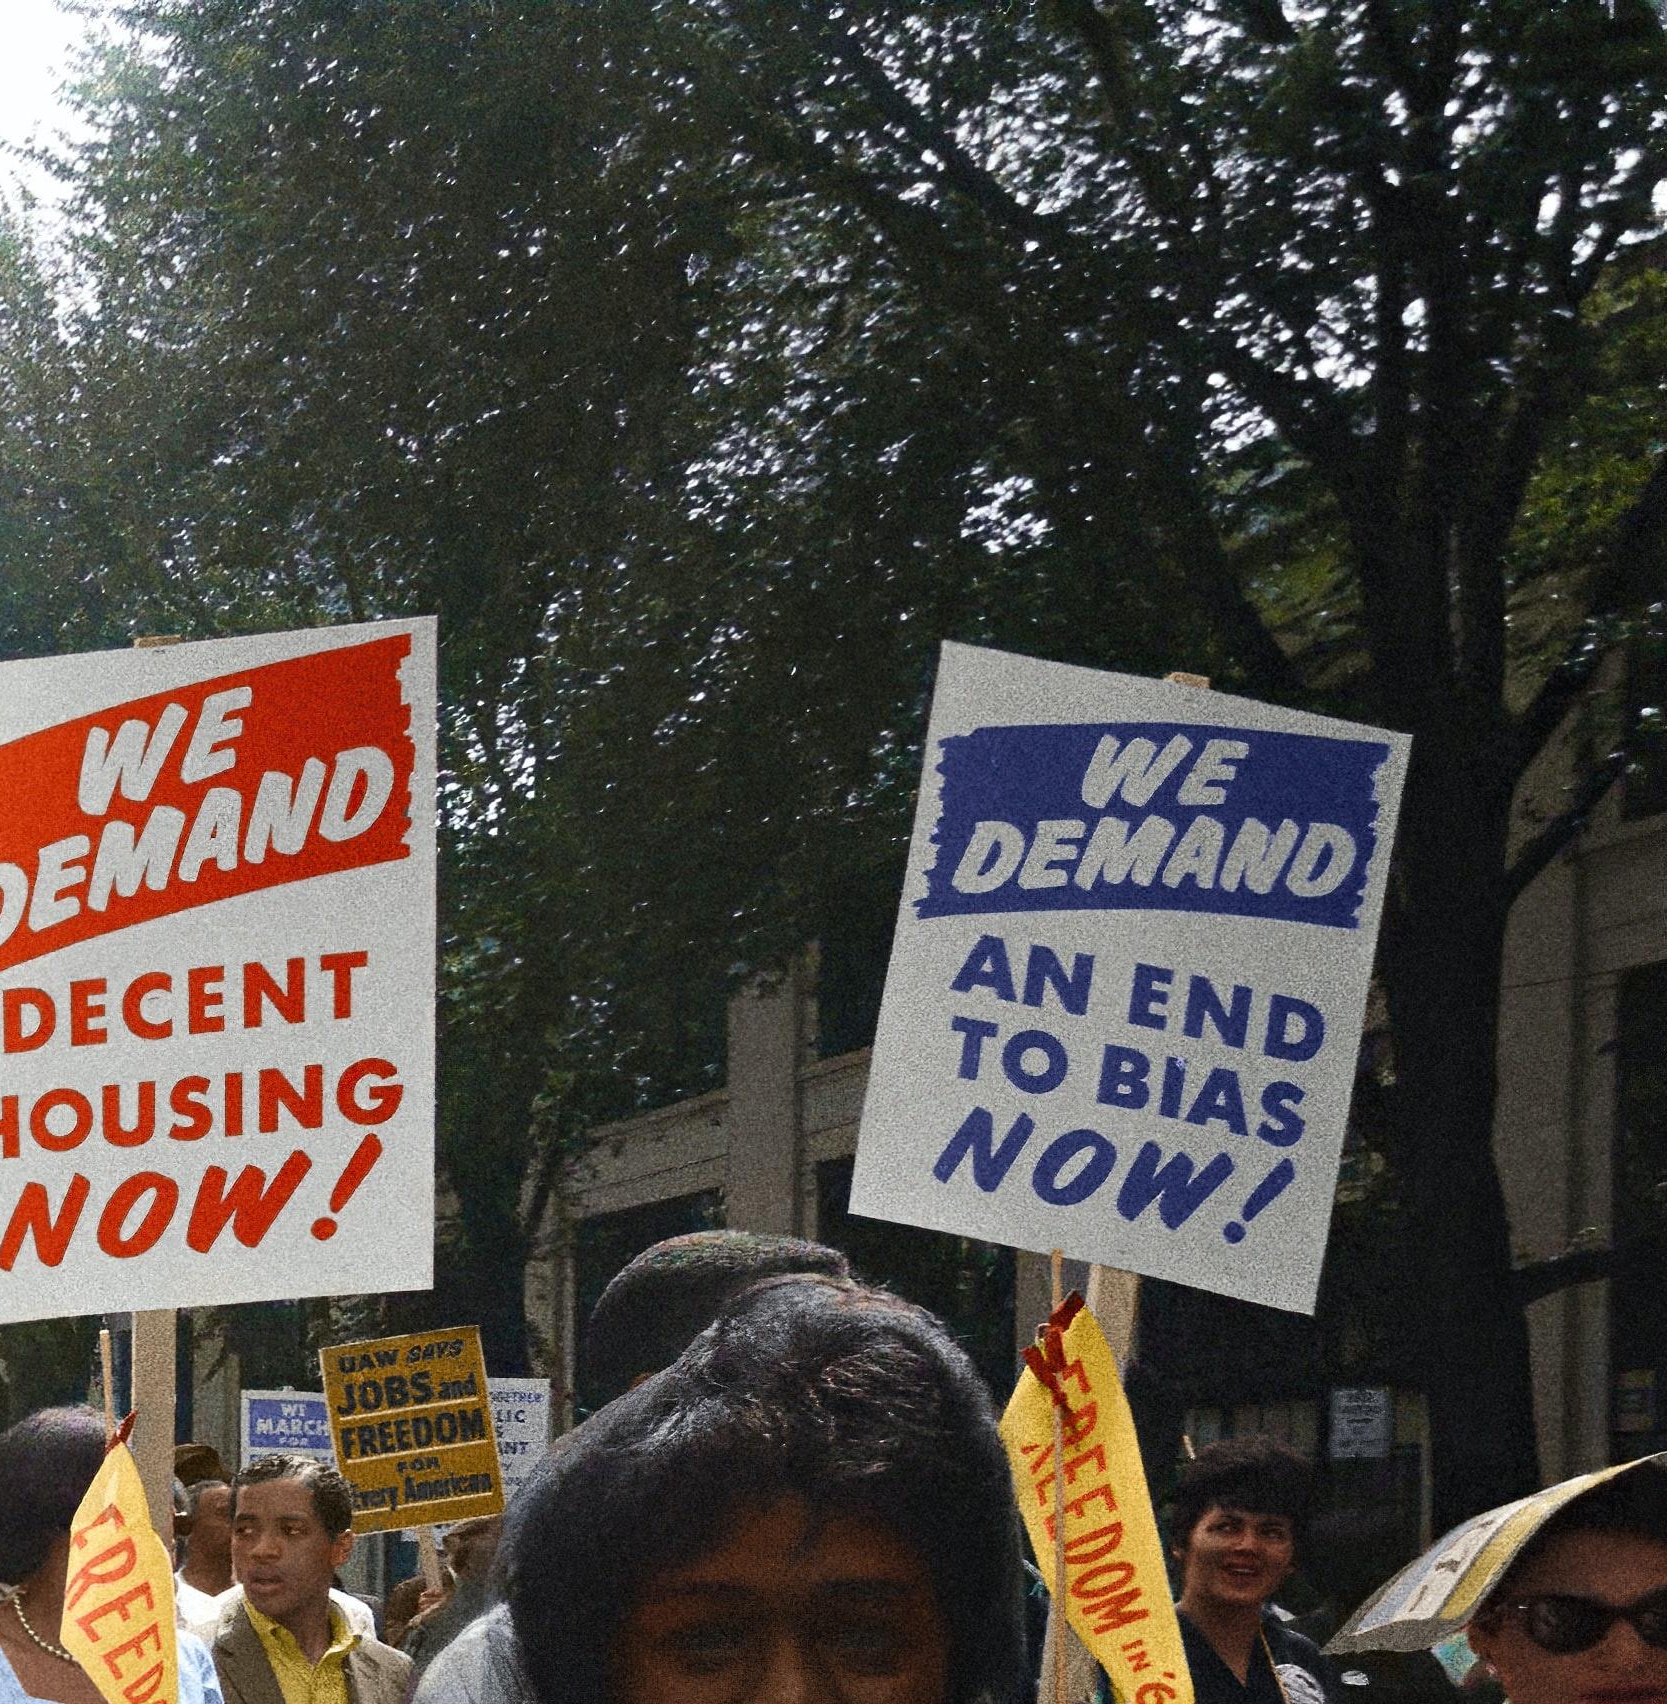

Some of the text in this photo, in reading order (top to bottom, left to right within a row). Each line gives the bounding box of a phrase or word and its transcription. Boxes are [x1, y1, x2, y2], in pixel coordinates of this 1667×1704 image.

[77, 686, 251, 816] WE
[1080, 731, 1250, 809] WE
[951, 816, 1358, 899] DEMAND
[2, 951, 368, 1054] DECENT
[949, 933, 1326, 1063] AN END
[951, 1015, 1307, 1149] TO BIAS
[932, 1106, 1296, 1246] NOW!
[338, 1339, 464, 1374] UAW SAYS
[337, 1370, 477, 1417] JOBS and
[496, 1409, 525, 1423] LIC
[255, 1418, 329, 1436] MARCH
[341, 1408, 485, 1460] FREEDOM
[404, 1472, 493, 1504] American
[1122, 1638, 1153, 1674] IN
